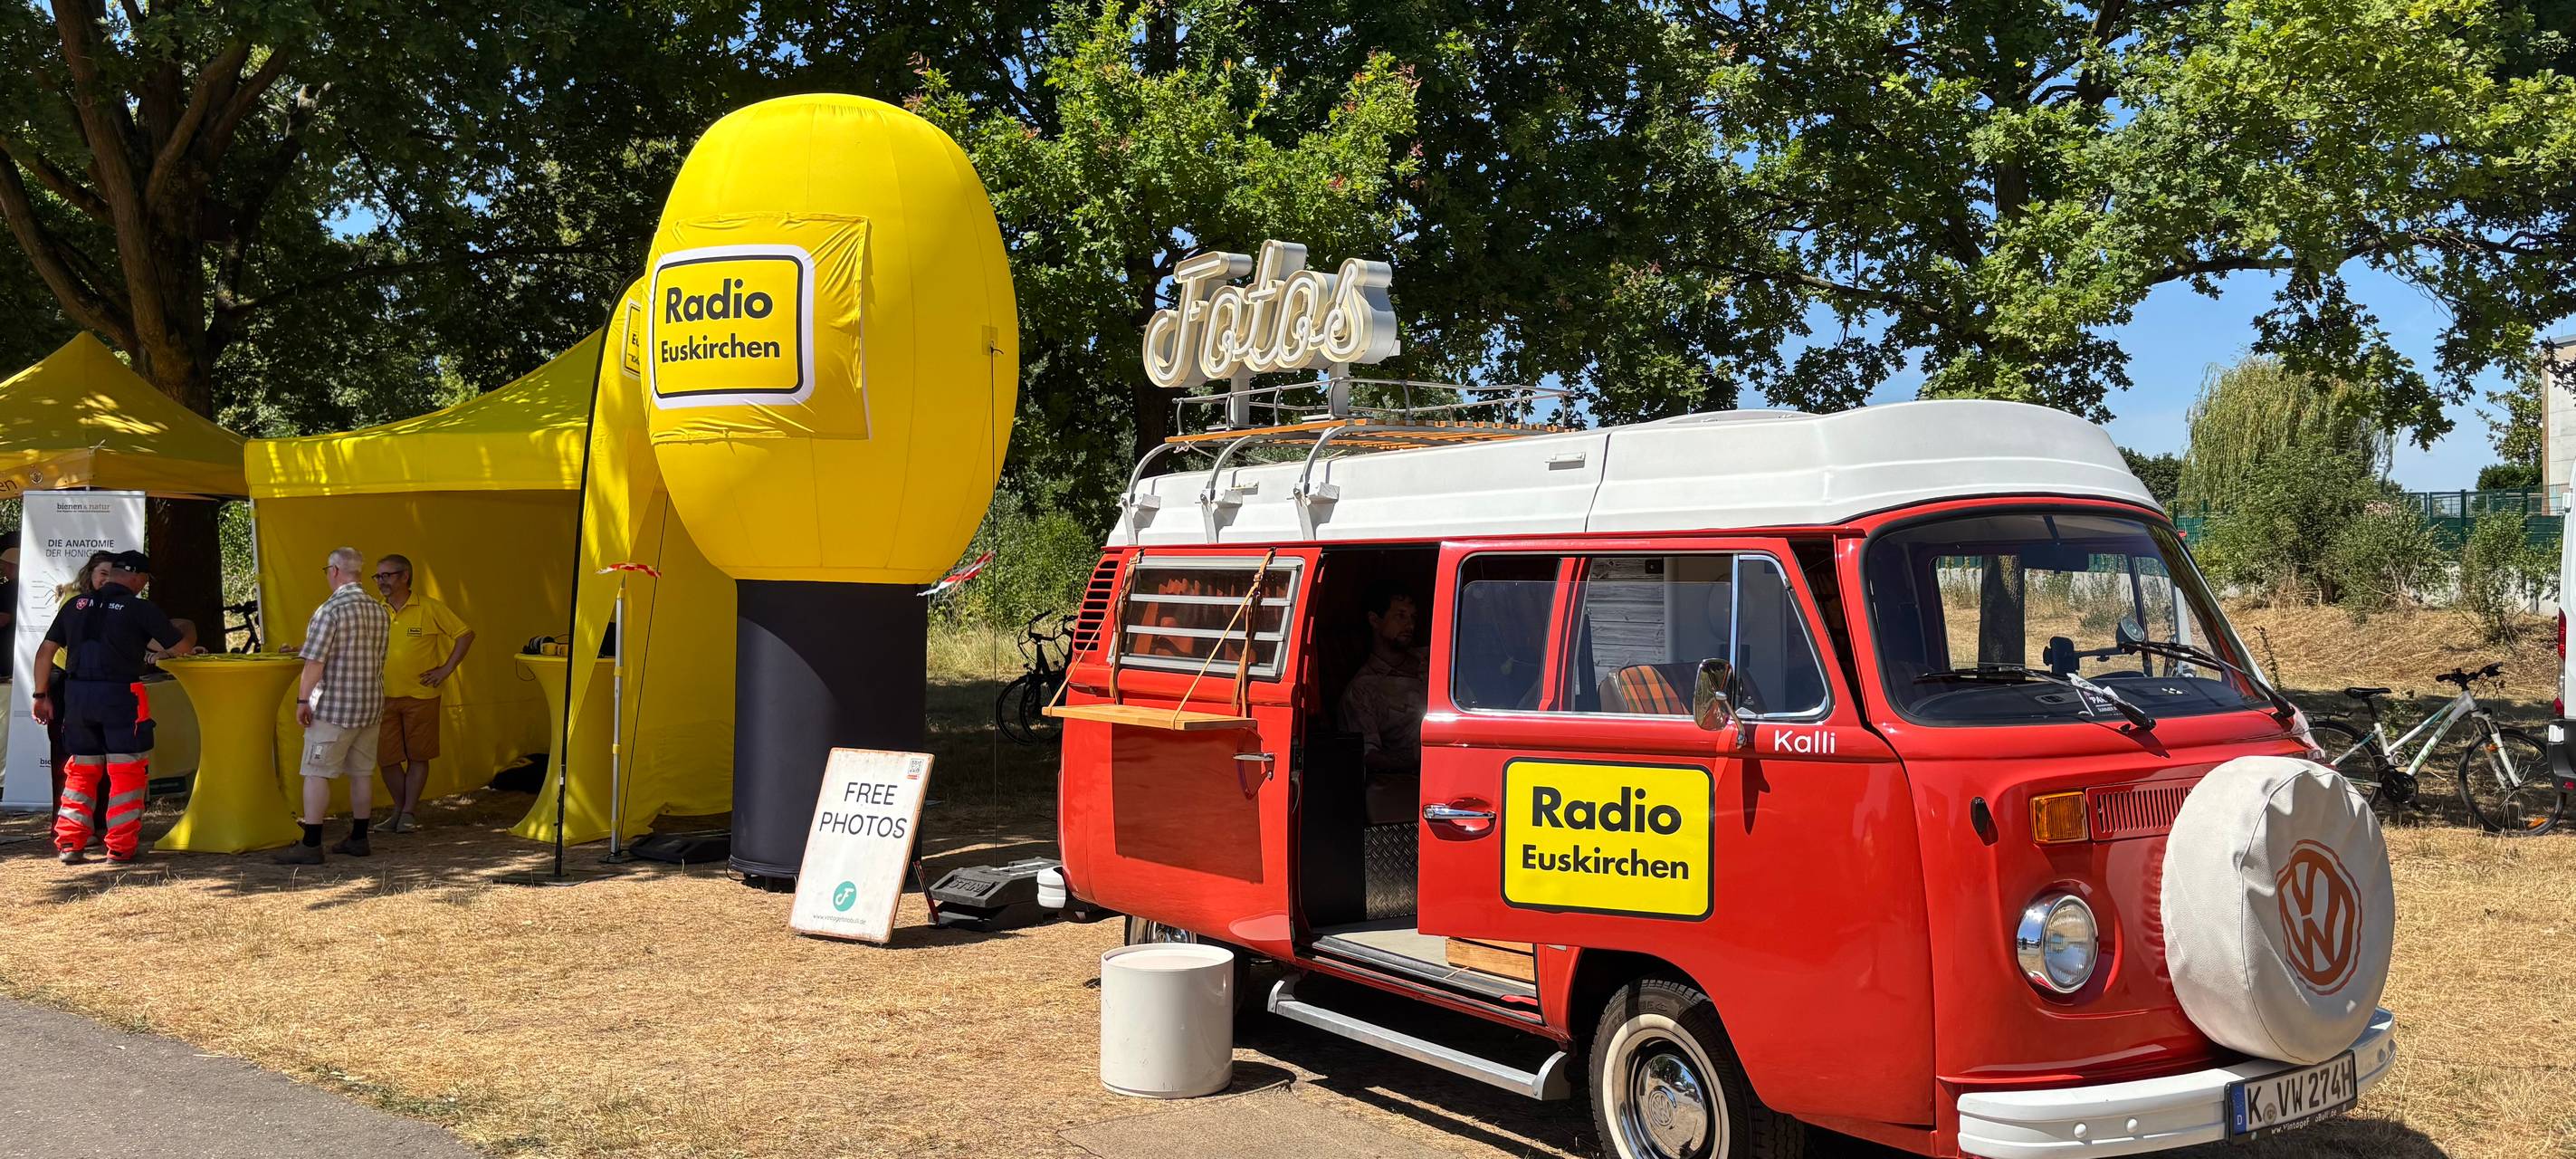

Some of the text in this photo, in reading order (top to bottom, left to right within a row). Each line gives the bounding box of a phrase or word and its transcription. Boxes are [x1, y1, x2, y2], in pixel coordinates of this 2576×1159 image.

[665, 277, 774, 324] Radio
[1143, 239, 1398, 388] Fotos
[661, 332, 781, 363] Euskirchen
[45, 549, 62, 558] DER
[48, 539, 114, 548] DIE ANATOMIE
[1773, 729, 1837, 754] Kalli
[844, 781, 898, 806] FREE
[819, 811, 908, 839] PHOTOS
[1531, 785, 1682, 836] Radio
[1522, 843, 1690, 880] Euskirchen
[2247, 1058, 2353, 1125] K VW 274H
[2237, 1115, 2243, 1125] D
